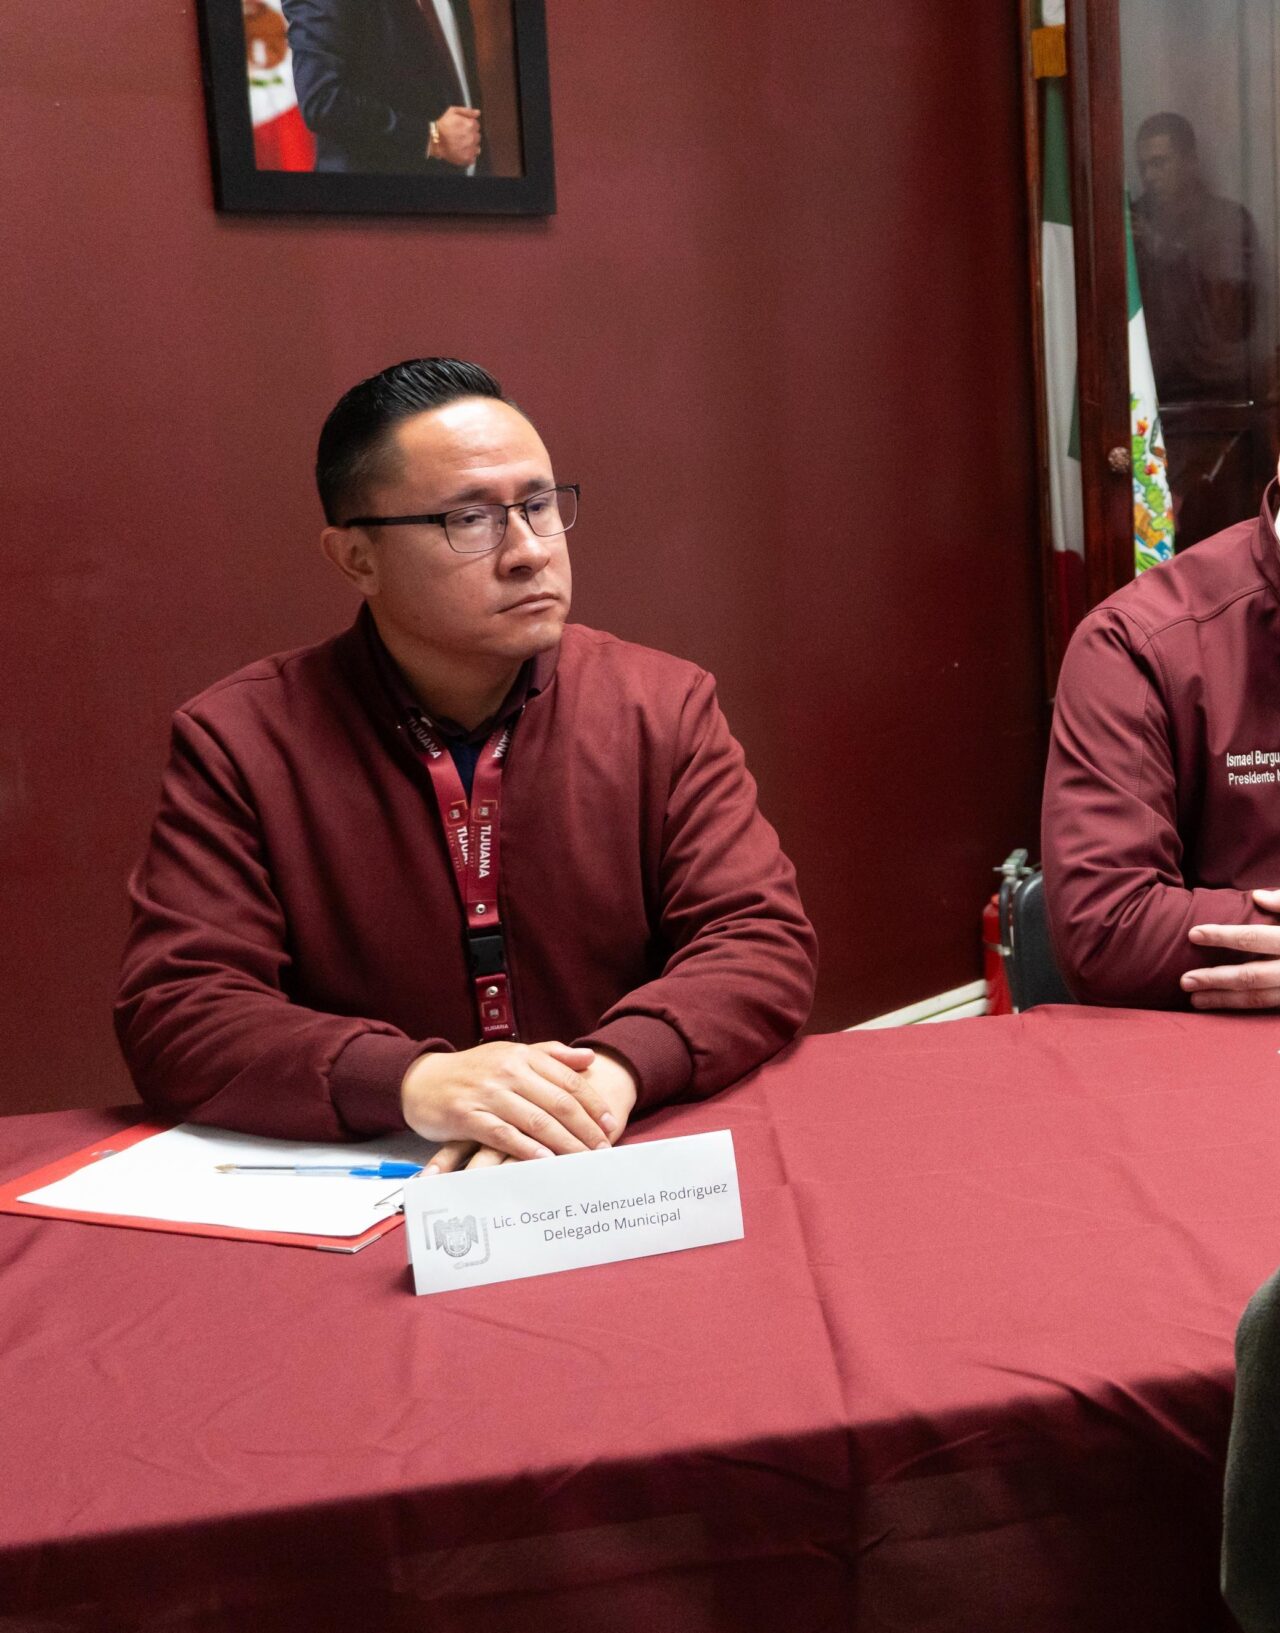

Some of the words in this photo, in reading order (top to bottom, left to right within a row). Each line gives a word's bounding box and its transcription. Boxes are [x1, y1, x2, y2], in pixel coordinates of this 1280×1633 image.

[408, 717, 442, 759] TIJUANA
[1226, 751, 1254, 767] Ismael
[1228, 771, 1275, 786] Presidente
[479, 825, 492, 879] TIJUANA
[493, 1216, 516, 1229] Lic.
[520, 1208, 560, 1224] Oscar
[565, 1205, 577, 1217] E.
[581, 1193, 656, 1214] Valenzuela
[660, 1183, 728, 1202] Rodriguez
[544, 1221, 610, 1241] Delegado
[614, 1208, 681, 1231] Municipal
